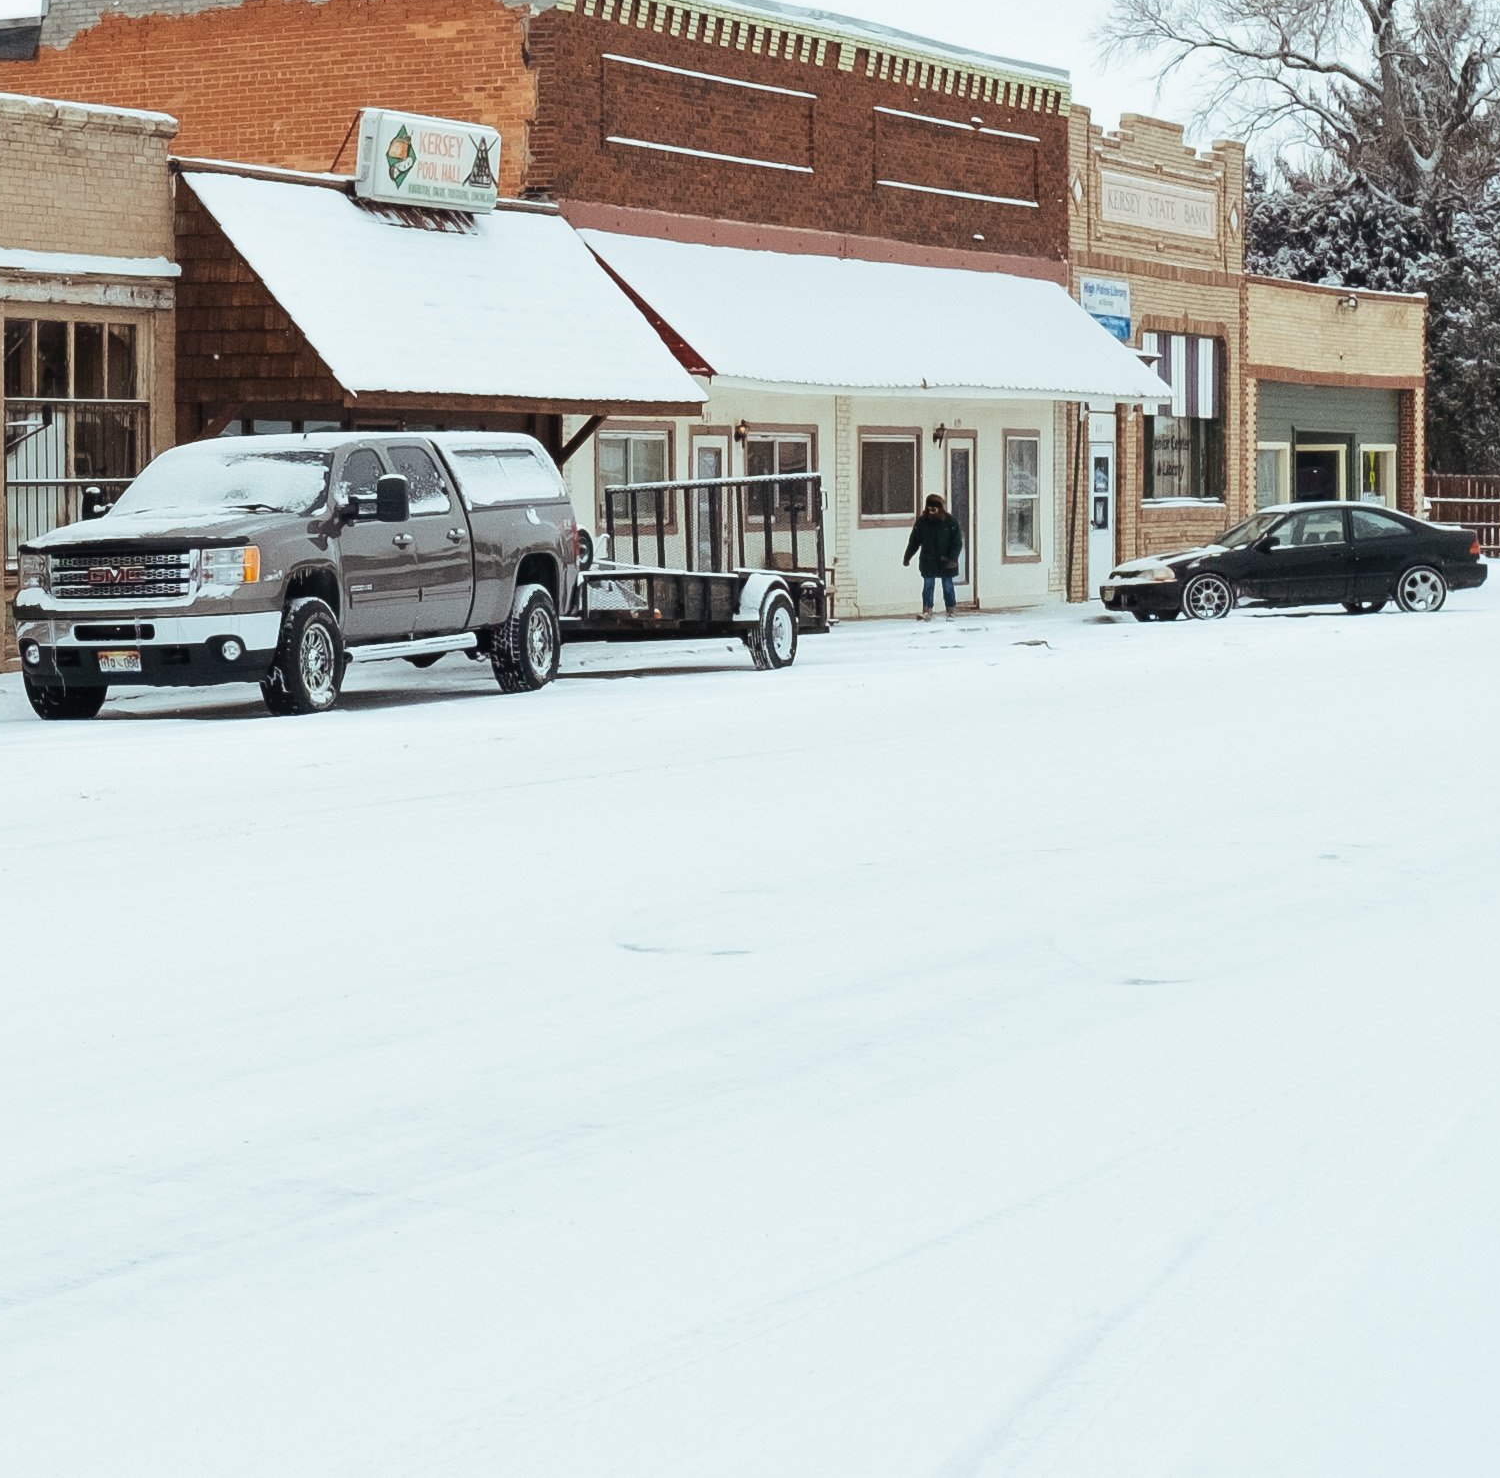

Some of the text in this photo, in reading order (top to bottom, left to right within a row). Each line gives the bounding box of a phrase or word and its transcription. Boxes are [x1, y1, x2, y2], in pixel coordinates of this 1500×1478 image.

[419, 131, 464, 159] KERSEY
[416, 160, 461, 184] POOL HALL
[1107, 188, 1209, 226] KERSEY STATE BANK
[88, 566, 146, 584] GMC
